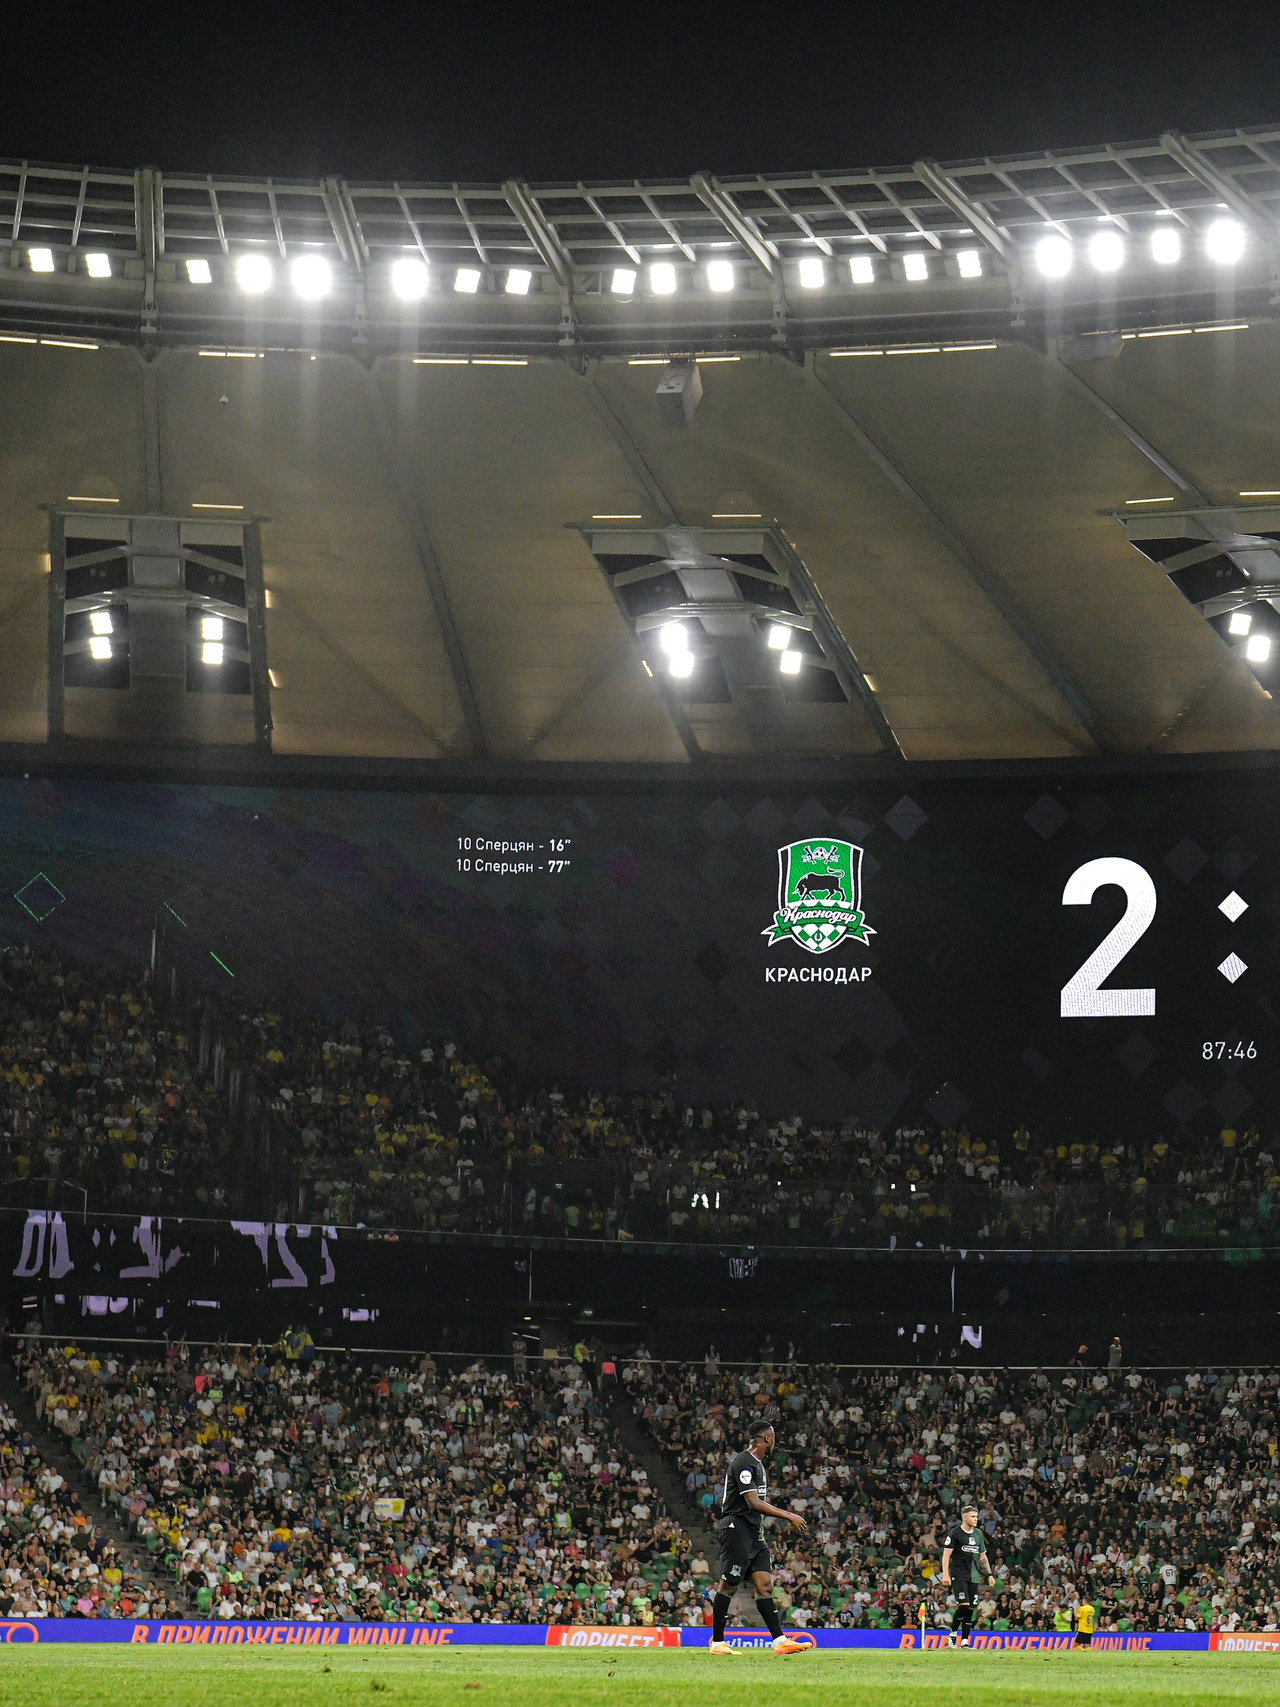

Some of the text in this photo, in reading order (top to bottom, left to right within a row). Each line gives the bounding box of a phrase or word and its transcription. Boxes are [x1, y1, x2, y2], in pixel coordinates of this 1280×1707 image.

[457, 837, 472, 850] 10
[475, 837, 534, 854] Сперцян
[457, 858, 471, 872] 10
[474, 858, 534, 876] Сперцян
[780, 906, 857, 925] Краснодар
[1060, 857, 1157, 1018] 2
[765, 967, 872, 985] КРАСНОДАР
[1202, 1041, 1257, 1060] 87:46
[131, 1624, 150, 1644] В
[157, 1625, 340, 1645] ПРИЛОЖЕНИИ
